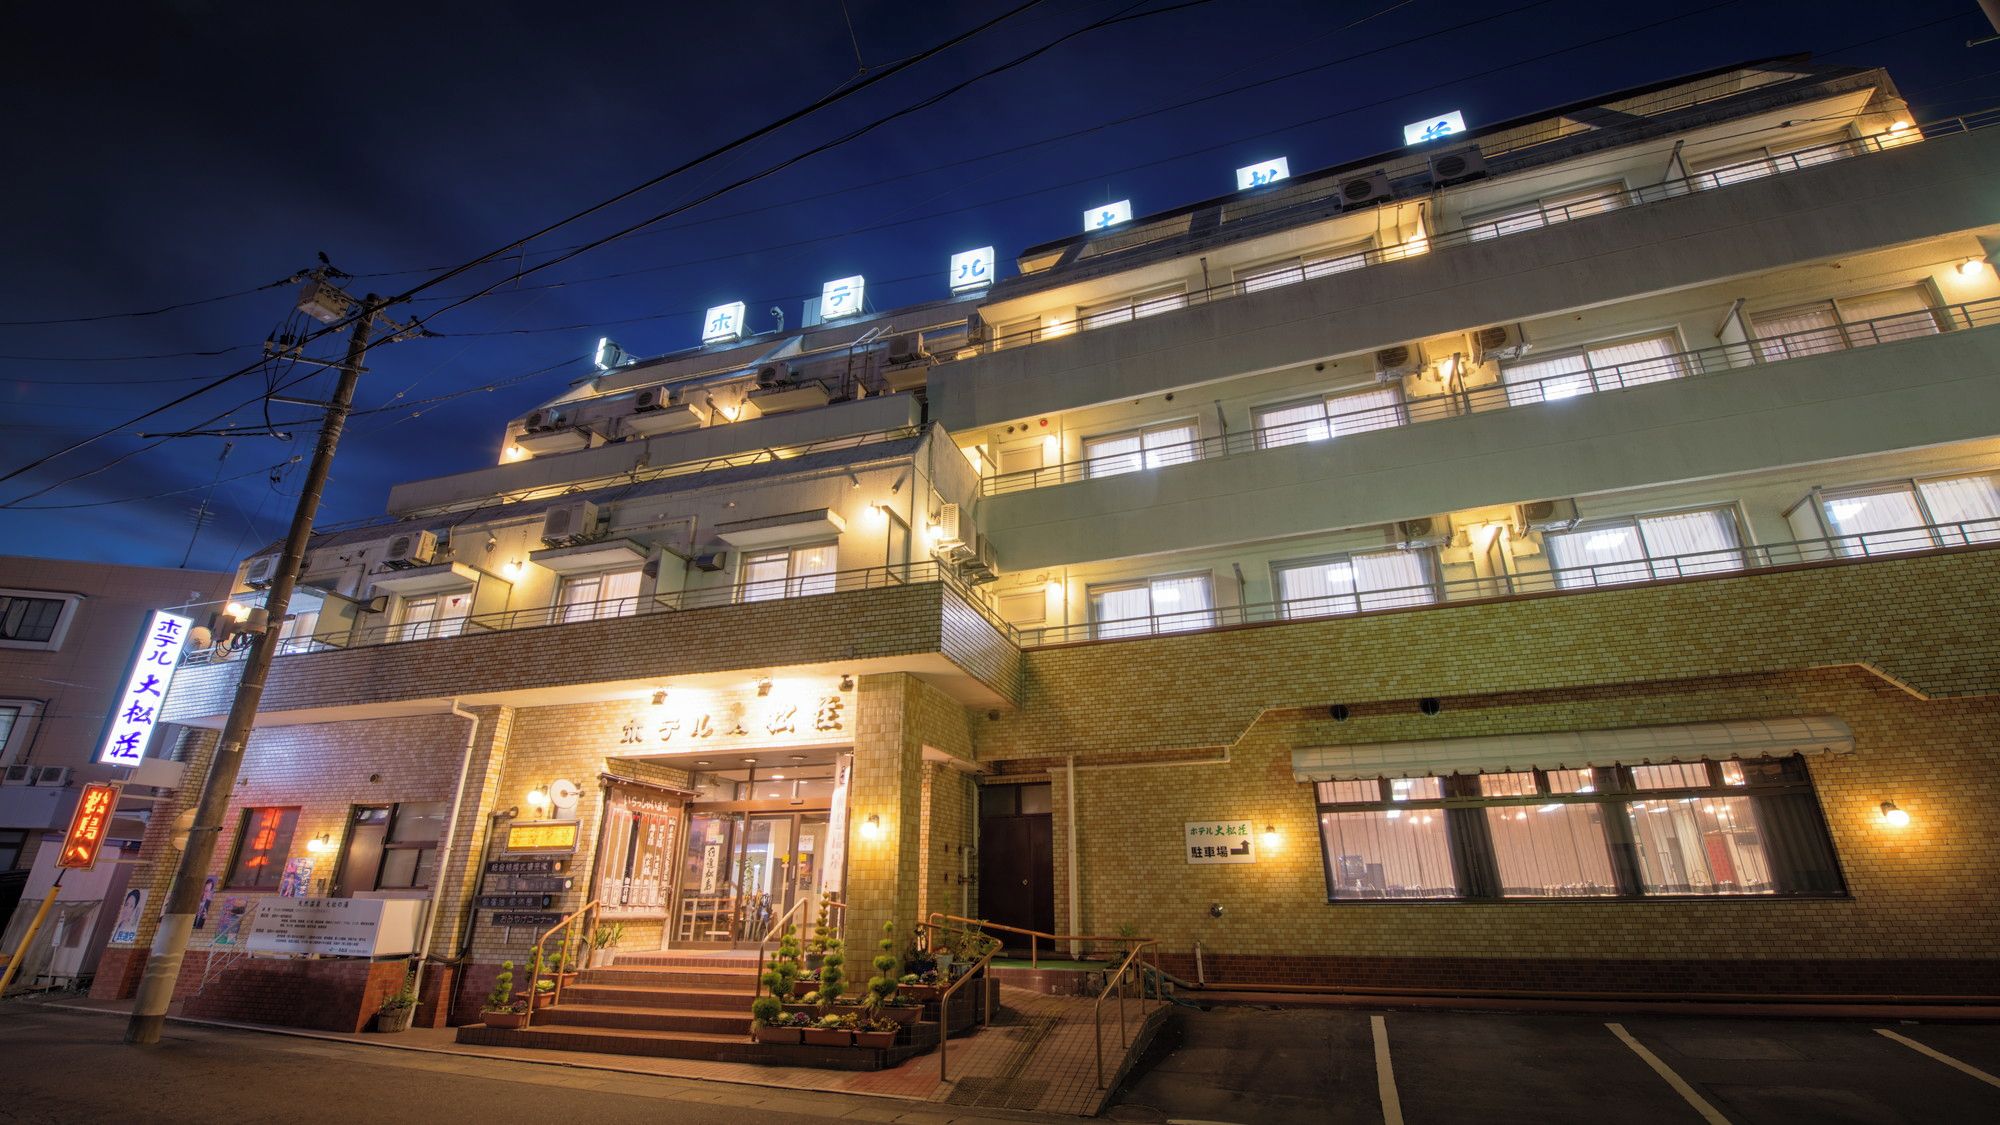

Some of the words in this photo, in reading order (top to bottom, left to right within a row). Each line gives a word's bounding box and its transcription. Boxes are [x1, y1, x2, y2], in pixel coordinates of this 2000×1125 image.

[110, 619, 182, 758] ホテル大松荘
[1191, 846, 1228, 858] 駐車場
